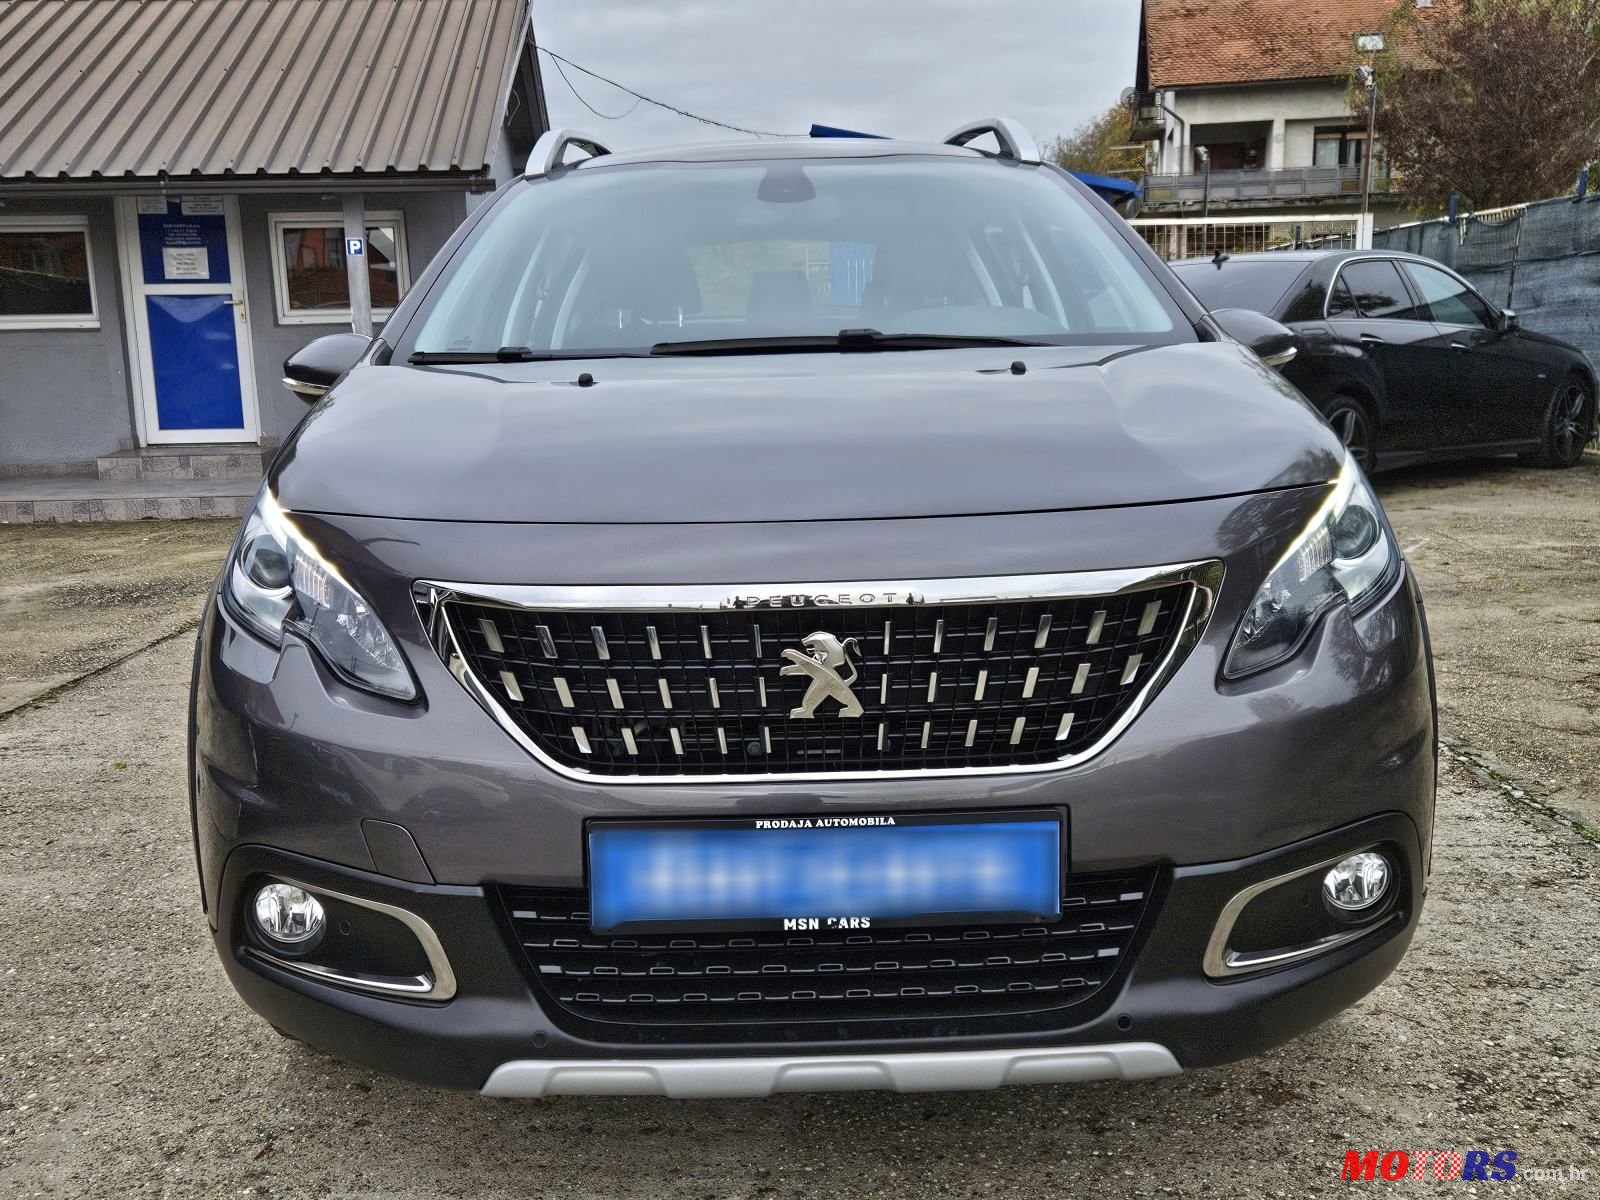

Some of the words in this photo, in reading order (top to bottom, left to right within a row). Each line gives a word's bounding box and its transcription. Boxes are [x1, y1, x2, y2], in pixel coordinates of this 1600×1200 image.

[350, 240, 361, 254] P
[746, 592, 897, 607] PEUGEOT
[755, 819, 813, 829] PRODAJA
[815, 816, 896, 828] AUTOMOBILA
[783, 917, 820, 931] MSN
